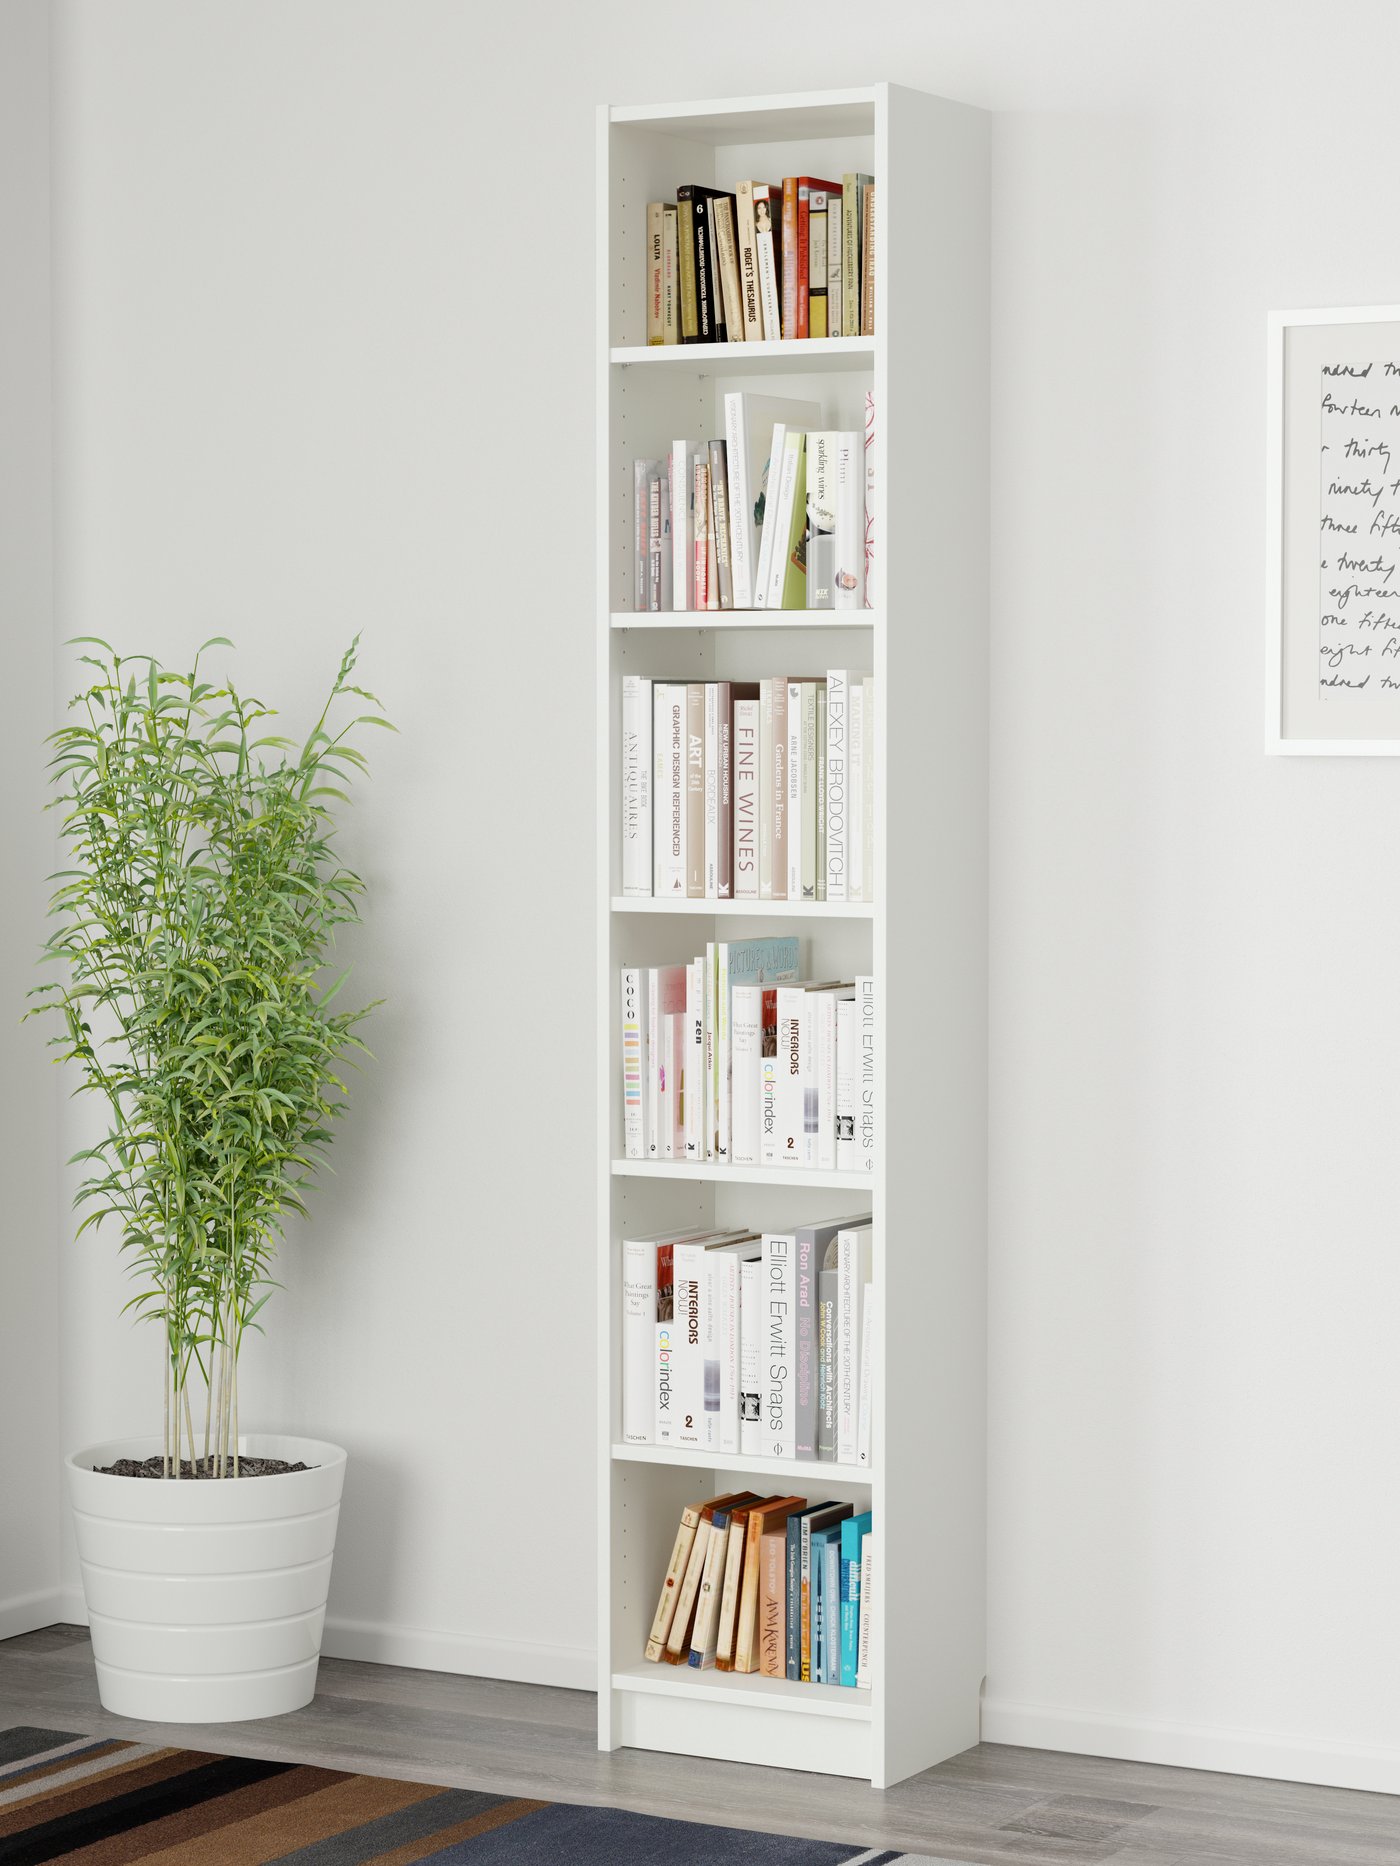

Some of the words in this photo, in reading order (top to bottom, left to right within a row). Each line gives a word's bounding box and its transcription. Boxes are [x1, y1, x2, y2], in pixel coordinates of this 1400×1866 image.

[696, 204, 704, 214] 6
[798, 211, 807, 238] Getting
[653, 234, 661, 260] LOLITA
[743, 247, 755, 277] ROGET'S
[799, 246, 807, 280] Published
[746, 280, 757, 323] THESAURUS
[729, 399, 737, 431] VISIONARY
[1322, 393, 1381, 418] fourteen
[730, 432, 740, 484] ARCHITECTURE
[815, 439, 827, 474] sparkling
[1344, 438, 1391, 475] thirty
[651, 481, 659, 492] THE
[733, 493, 742, 506] THE
[816, 477, 826, 500] wines
[1328, 476, 1384, 508] ninety
[735, 508, 743, 525] 20TH
[1321, 514, 1358, 533] three
[735, 526, 744, 562] CENTURY
[1337, 552, 1395, 583] twenty
[1321, 615, 1348, 626] one
[1320, 643, 1372, 668] eight
[807, 694, 815, 722] TEXTILE
[829, 676, 844, 753] ALEXEY
[851, 695, 861, 749] MAKING
[672, 704, 681, 749] GRAPHIC
[807, 722, 815, 761] DESIGNERS
[689, 734, 703, 767] ART
[738, 728, 754, 781] FINE
[790, 735, 798, 756] ARNE
[851, 751, 861, 766] IT
[640, 770, 648, 780] THE
[672, 752, 681, 788] DESIGN
[774, 743, 784, 788] Gardens
[790, 758, 798, 799] JACOBSEN
[627, 731, 639, 839] ANTIQUAIRES
[640, 794, 648, 808] BOOK
[706, 769, 716, 825] BORDEAUX
[775, 790, 784, 799] in
[672, 791, 681, 857] REFERENCED
[738, 792, 754, 872] WINES
[775, 804, 784, 840] France
[829, 759, 844, 886] BRODOVITCH
[626, 974, 636, 1019] COCO
[862, 981, 873, 1027] Elliott
[695, 1019, 703, 1045] zen
[780, 1018, 790, 1050] NOW!
[790, 1018, 799, 1075] INTERIORS
[862, 1034, 873, 1083] Erwitt
[763, 1064, 777, 1135] colorindex
[859, 1089, 873, 1148] Snaps
[787, 1137, 795, 1149] 2
[770, 1240, 788, 1294] Elliott
[799, 1242, 811, 1271] Ron
[843, 1238, 851, 1273] VISIONARY
[677, 1279, 689, 1316] NOW!
[799, 1274, 811, 1307] Arad
[843, 1274, 851, 1327] ARCHITECTURE
[688, 1280, 699, 1345] INTERIORS
[770, 1301, 788, 1358] Erwitt
[799, 1317, 811, 1336] No
[825, 1300, 833, 1362] Conversations
[843, 1328, 851, 1338] OF
[843, 1338, 851, 1353] THE
[659, 1330, 674, 1410] colorindex
[797, 1340, 811, 1406] Discipline
[825, 1365, 834, 1383] with
[843, 1355, 851, 1376] 20TH
[766, 1364, 788, 1431] Snaps
[825, 1385, 834, 1429] Architects
[843, 1377, 851, 1415] CENTURY
[685, 1415, 693, 1428] 2
[768, 1539, 776, 1555] LEO
[801, 1538, 809, 1570] O'BRIEN
[768, 1558, 776, 1594] TOLSTOY
[828, 1549, 836, 1587] DOWNTOWN
[841, 1558, 850, 1602] CONVERSATIONS
[849, 1560, 862, 1601] difficult
[829, 1588, 837, 1603] OWL
[864, 1571, 872, 1603] SMEIJERS
[829, 1605, 837, 1627] CHUCK
[829, 1628, 838, 1671] KLOSTERMAN
[861, 1613, 870, 1667] COUNTERPUNCH
